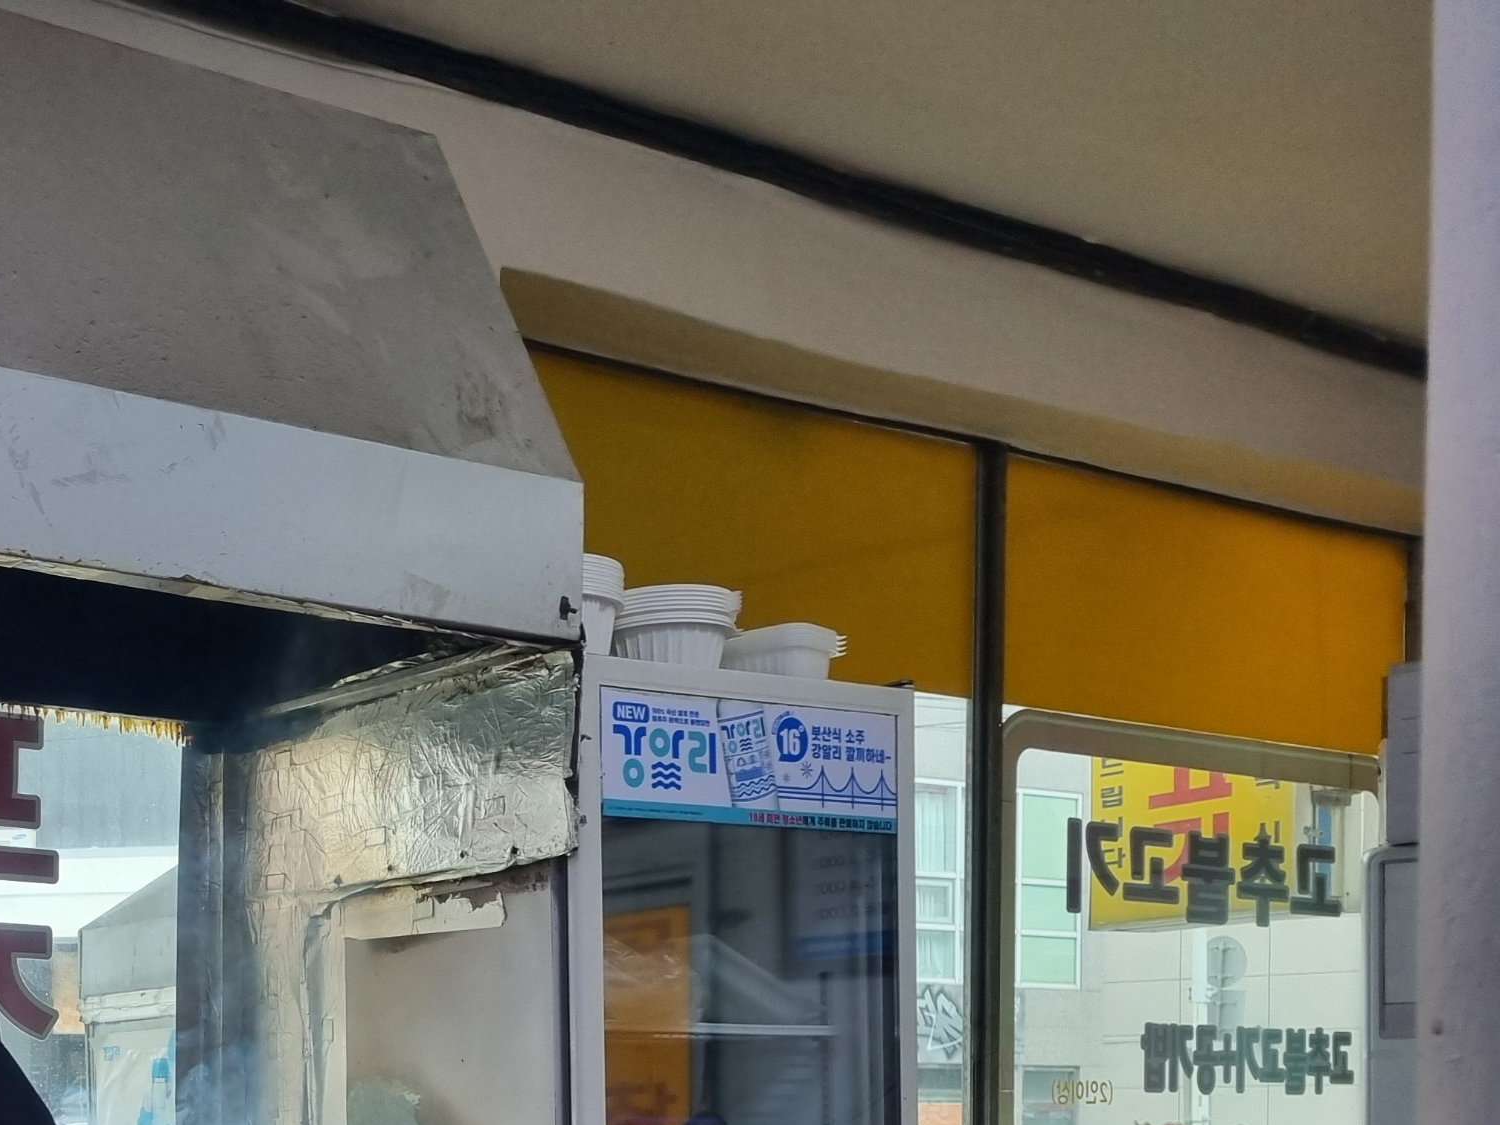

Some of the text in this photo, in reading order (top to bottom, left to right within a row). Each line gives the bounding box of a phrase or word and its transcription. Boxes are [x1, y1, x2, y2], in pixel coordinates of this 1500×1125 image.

[616, 704, 646, 721] NEW
[845, 729, 866, 746] 소주
[613, 724, 717, 791] 강알리
[811, 743, 842, 761] 강알리
